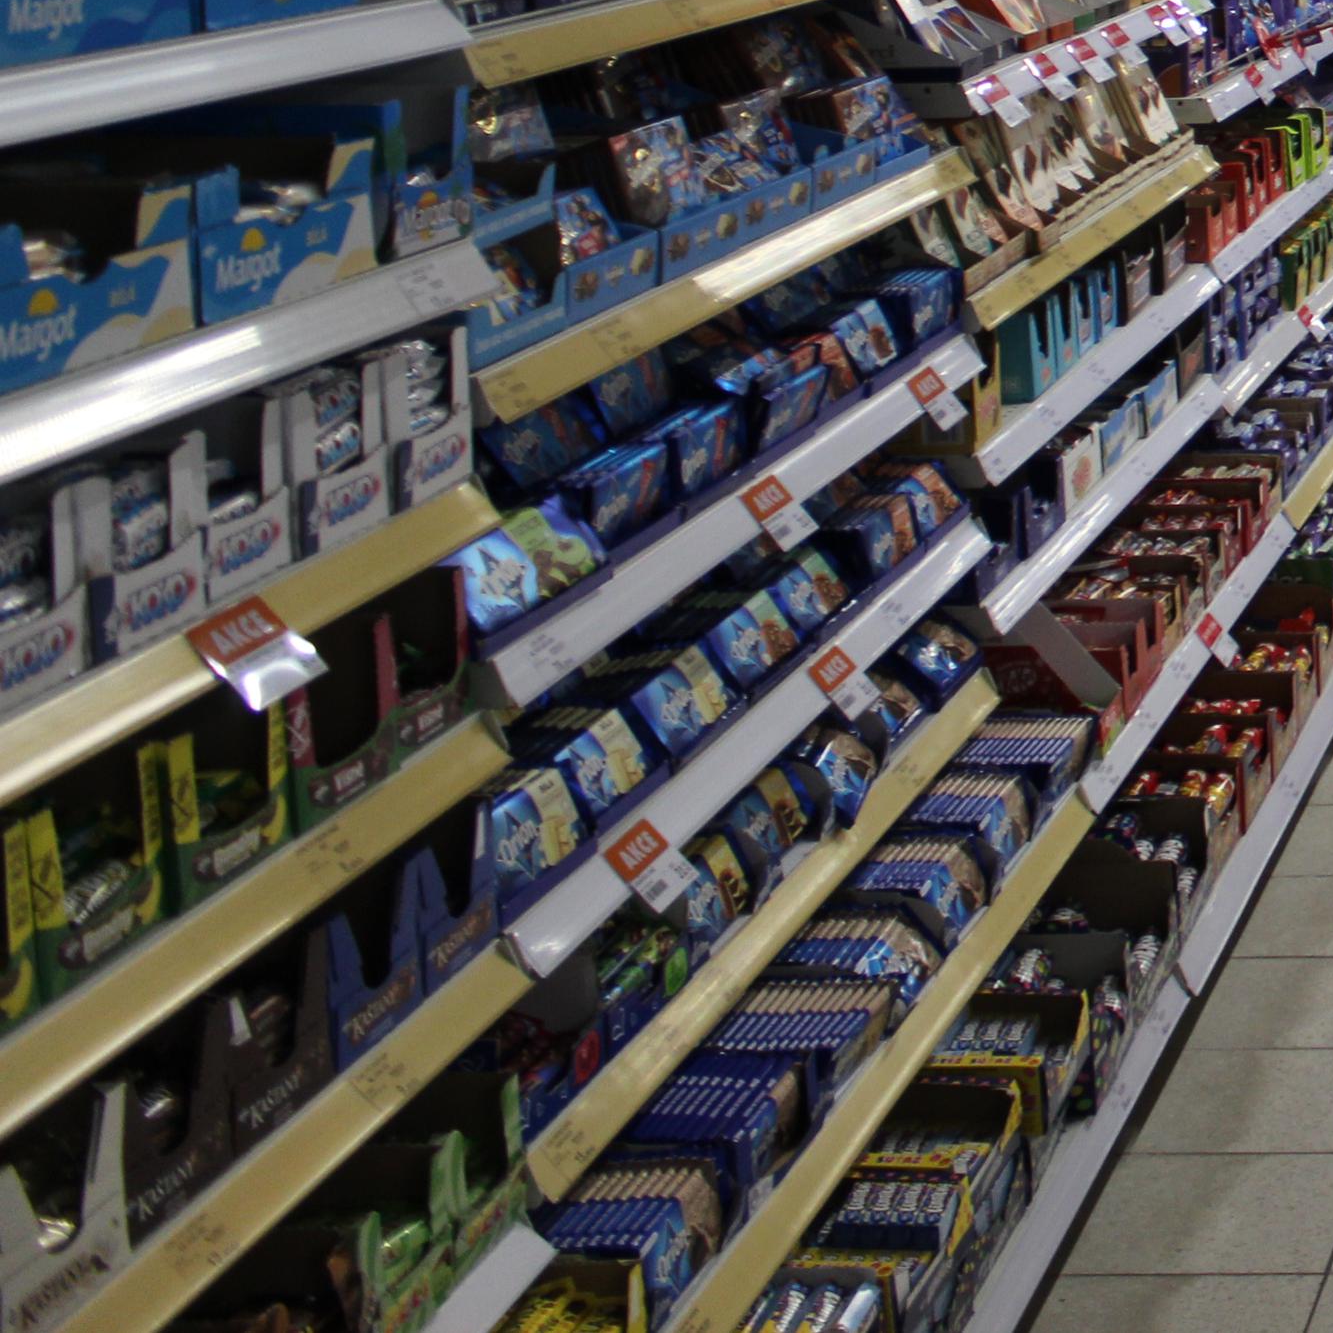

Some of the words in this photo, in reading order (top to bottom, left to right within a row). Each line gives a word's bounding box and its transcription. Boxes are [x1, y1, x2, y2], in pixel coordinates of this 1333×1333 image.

[216, 241, 281, 292] Margot
[0, 304, 77, 361] Margot
[207, 607, 277, 656] AKCE
[617, 830, 661, 871] AKCE
